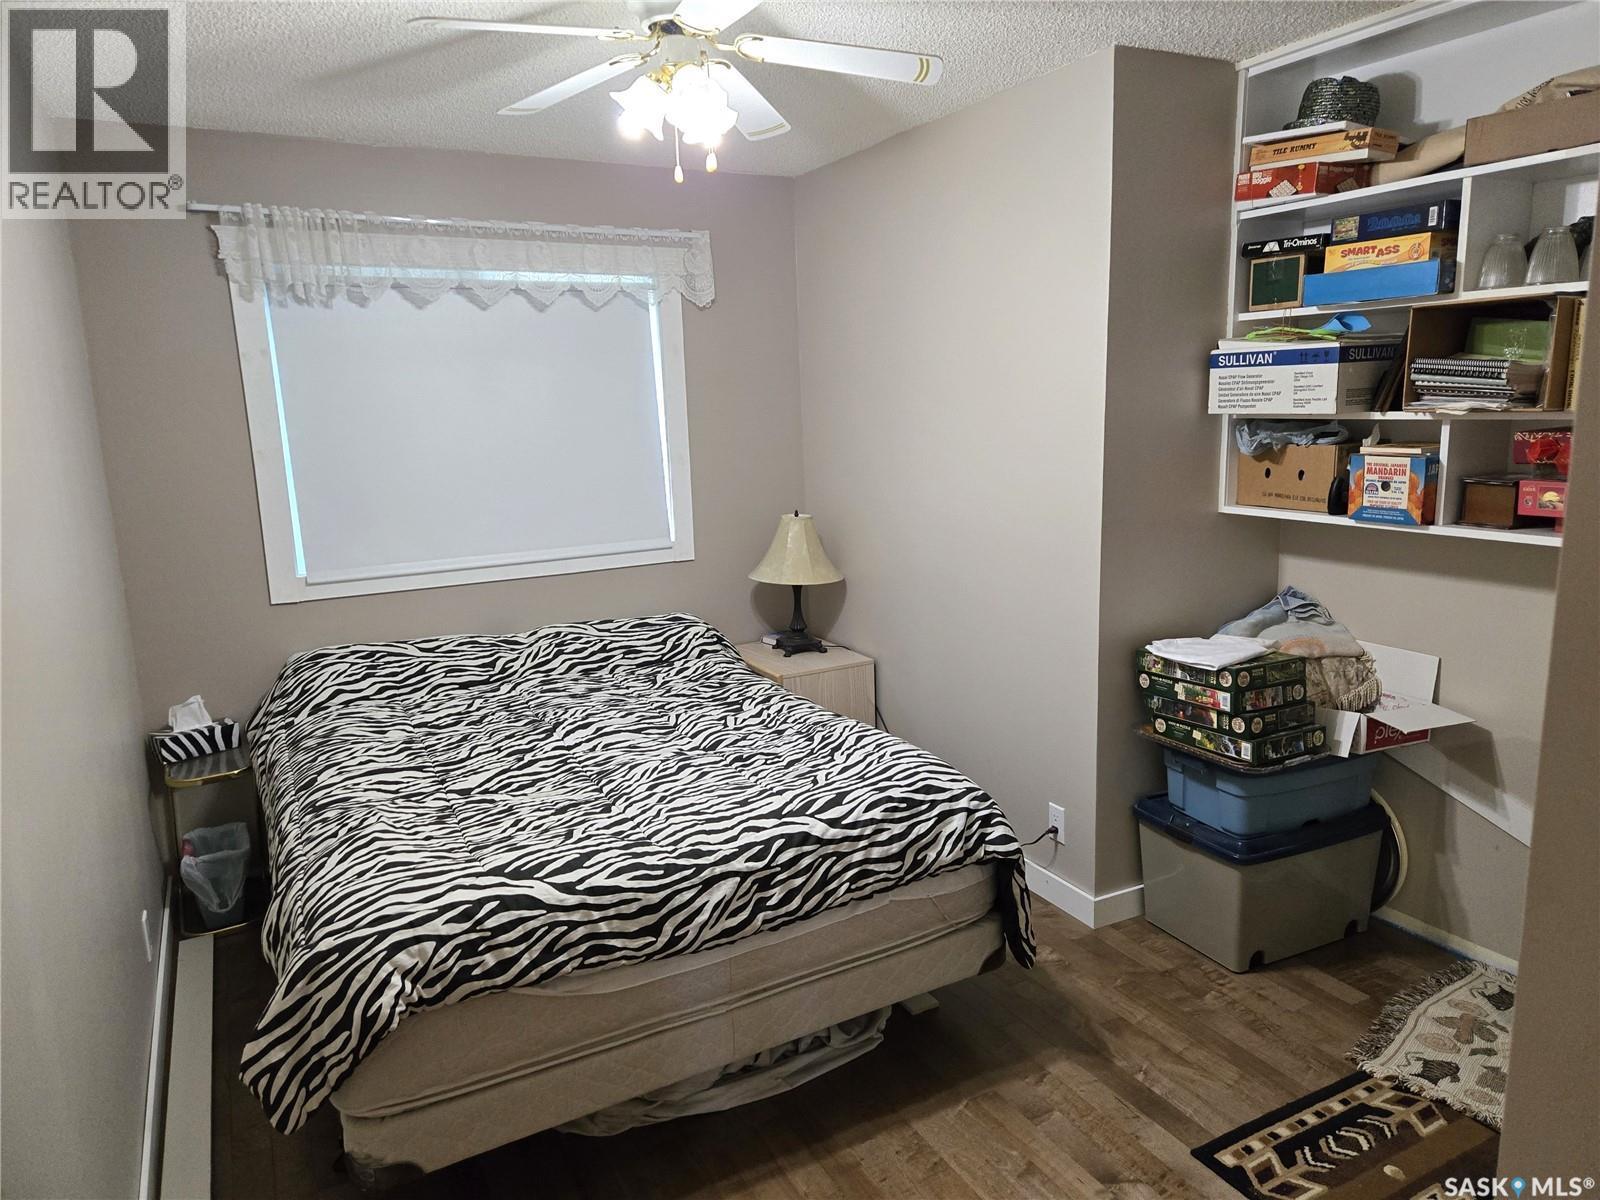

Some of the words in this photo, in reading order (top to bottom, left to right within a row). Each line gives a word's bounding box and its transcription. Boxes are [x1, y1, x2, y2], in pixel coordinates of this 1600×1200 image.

[1272, 147, 1288, 156] TILE
[1290, 143, 1318, 153] RUMMY
[1283, 237, 1318, 248] Tri-Ominos
[1340, 245, 1377, 258] SMART
[1376, 244, 1400, 258] ASS
[1349, 347, 1394, 360] SULLIVAN
[1366, 467, 1407, 476] MANDARIN
